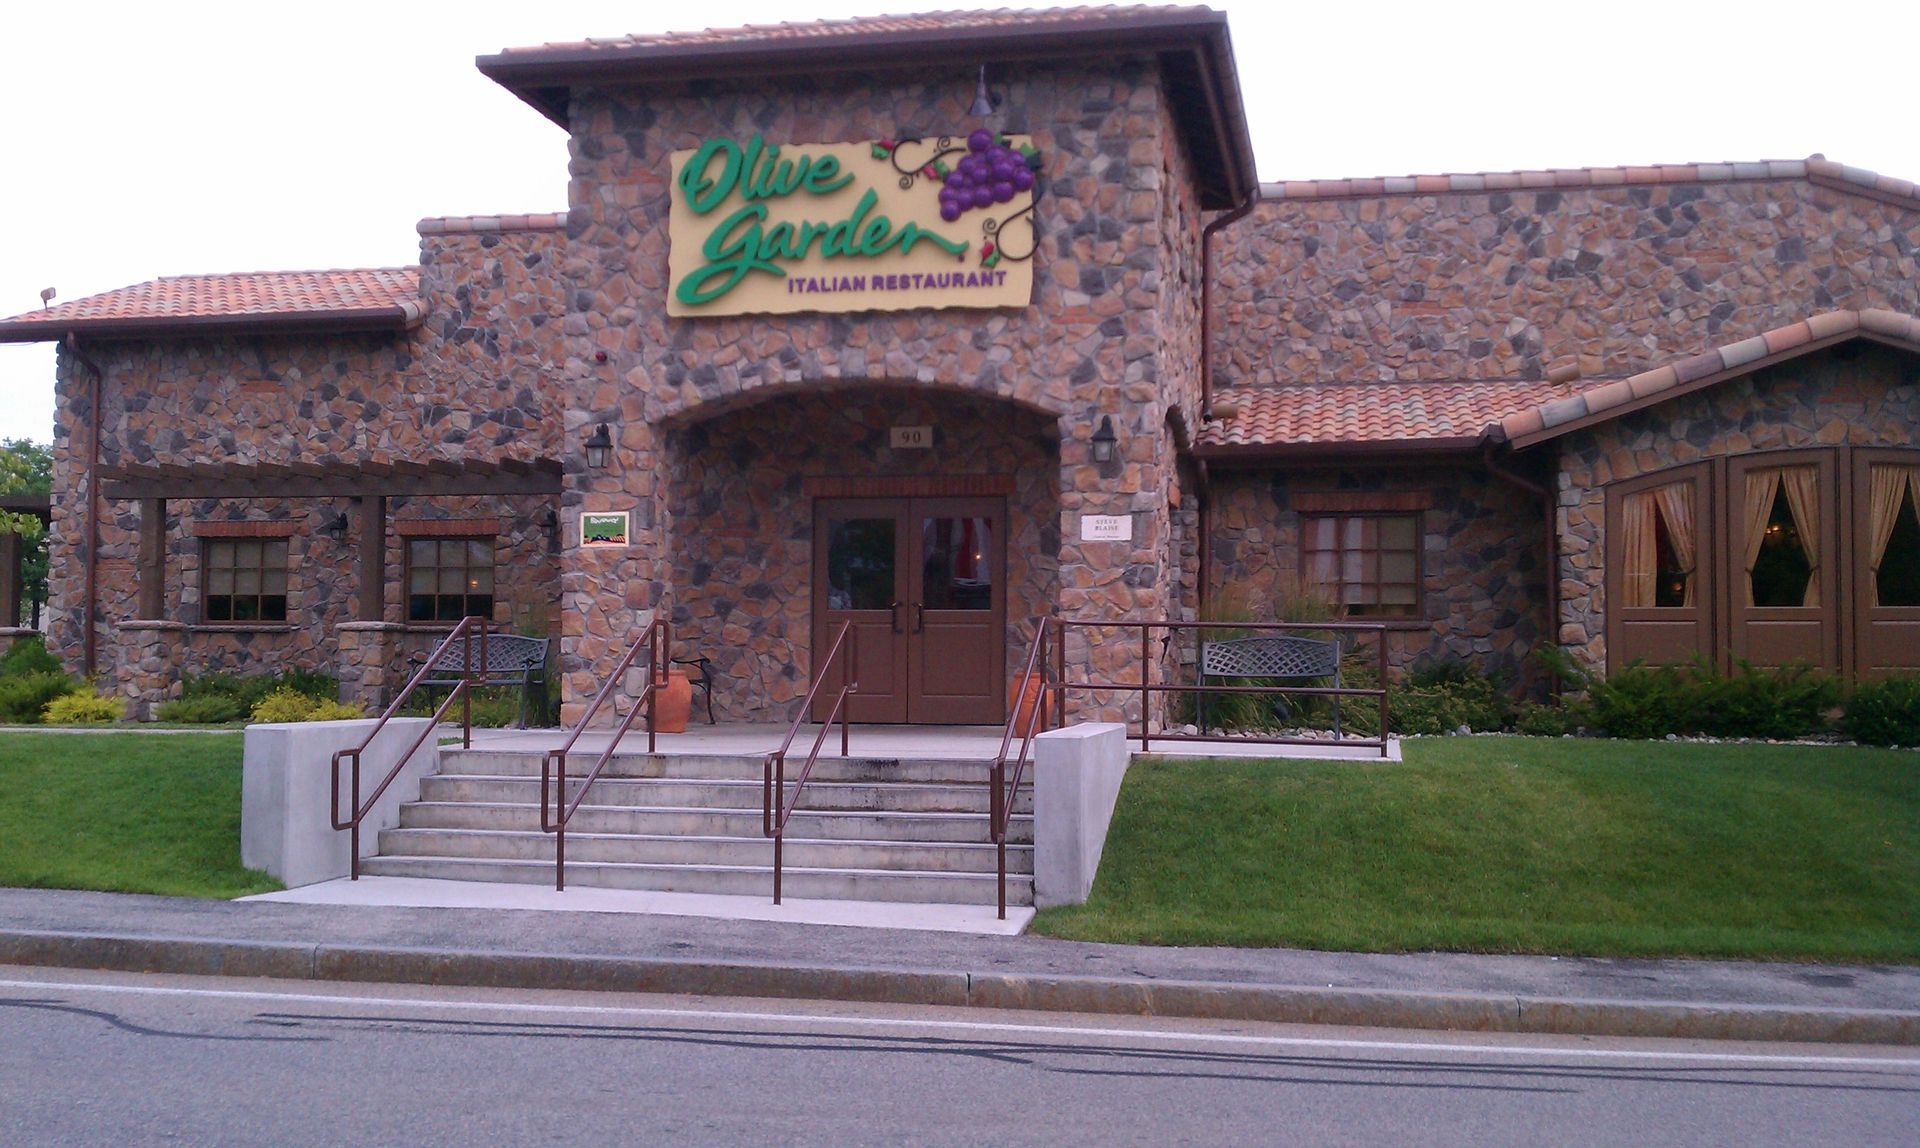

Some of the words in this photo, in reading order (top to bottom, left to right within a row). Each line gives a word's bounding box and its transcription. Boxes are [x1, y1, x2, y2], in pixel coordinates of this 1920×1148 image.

[678, 131, 856, 215] Olive
[674, 186, 970, 306] Garden
[788, 275, 866, 294] ITALIAN
[871, 270, 1007, 291] RESTAURANT
[901, 431, 921, 444] 90
